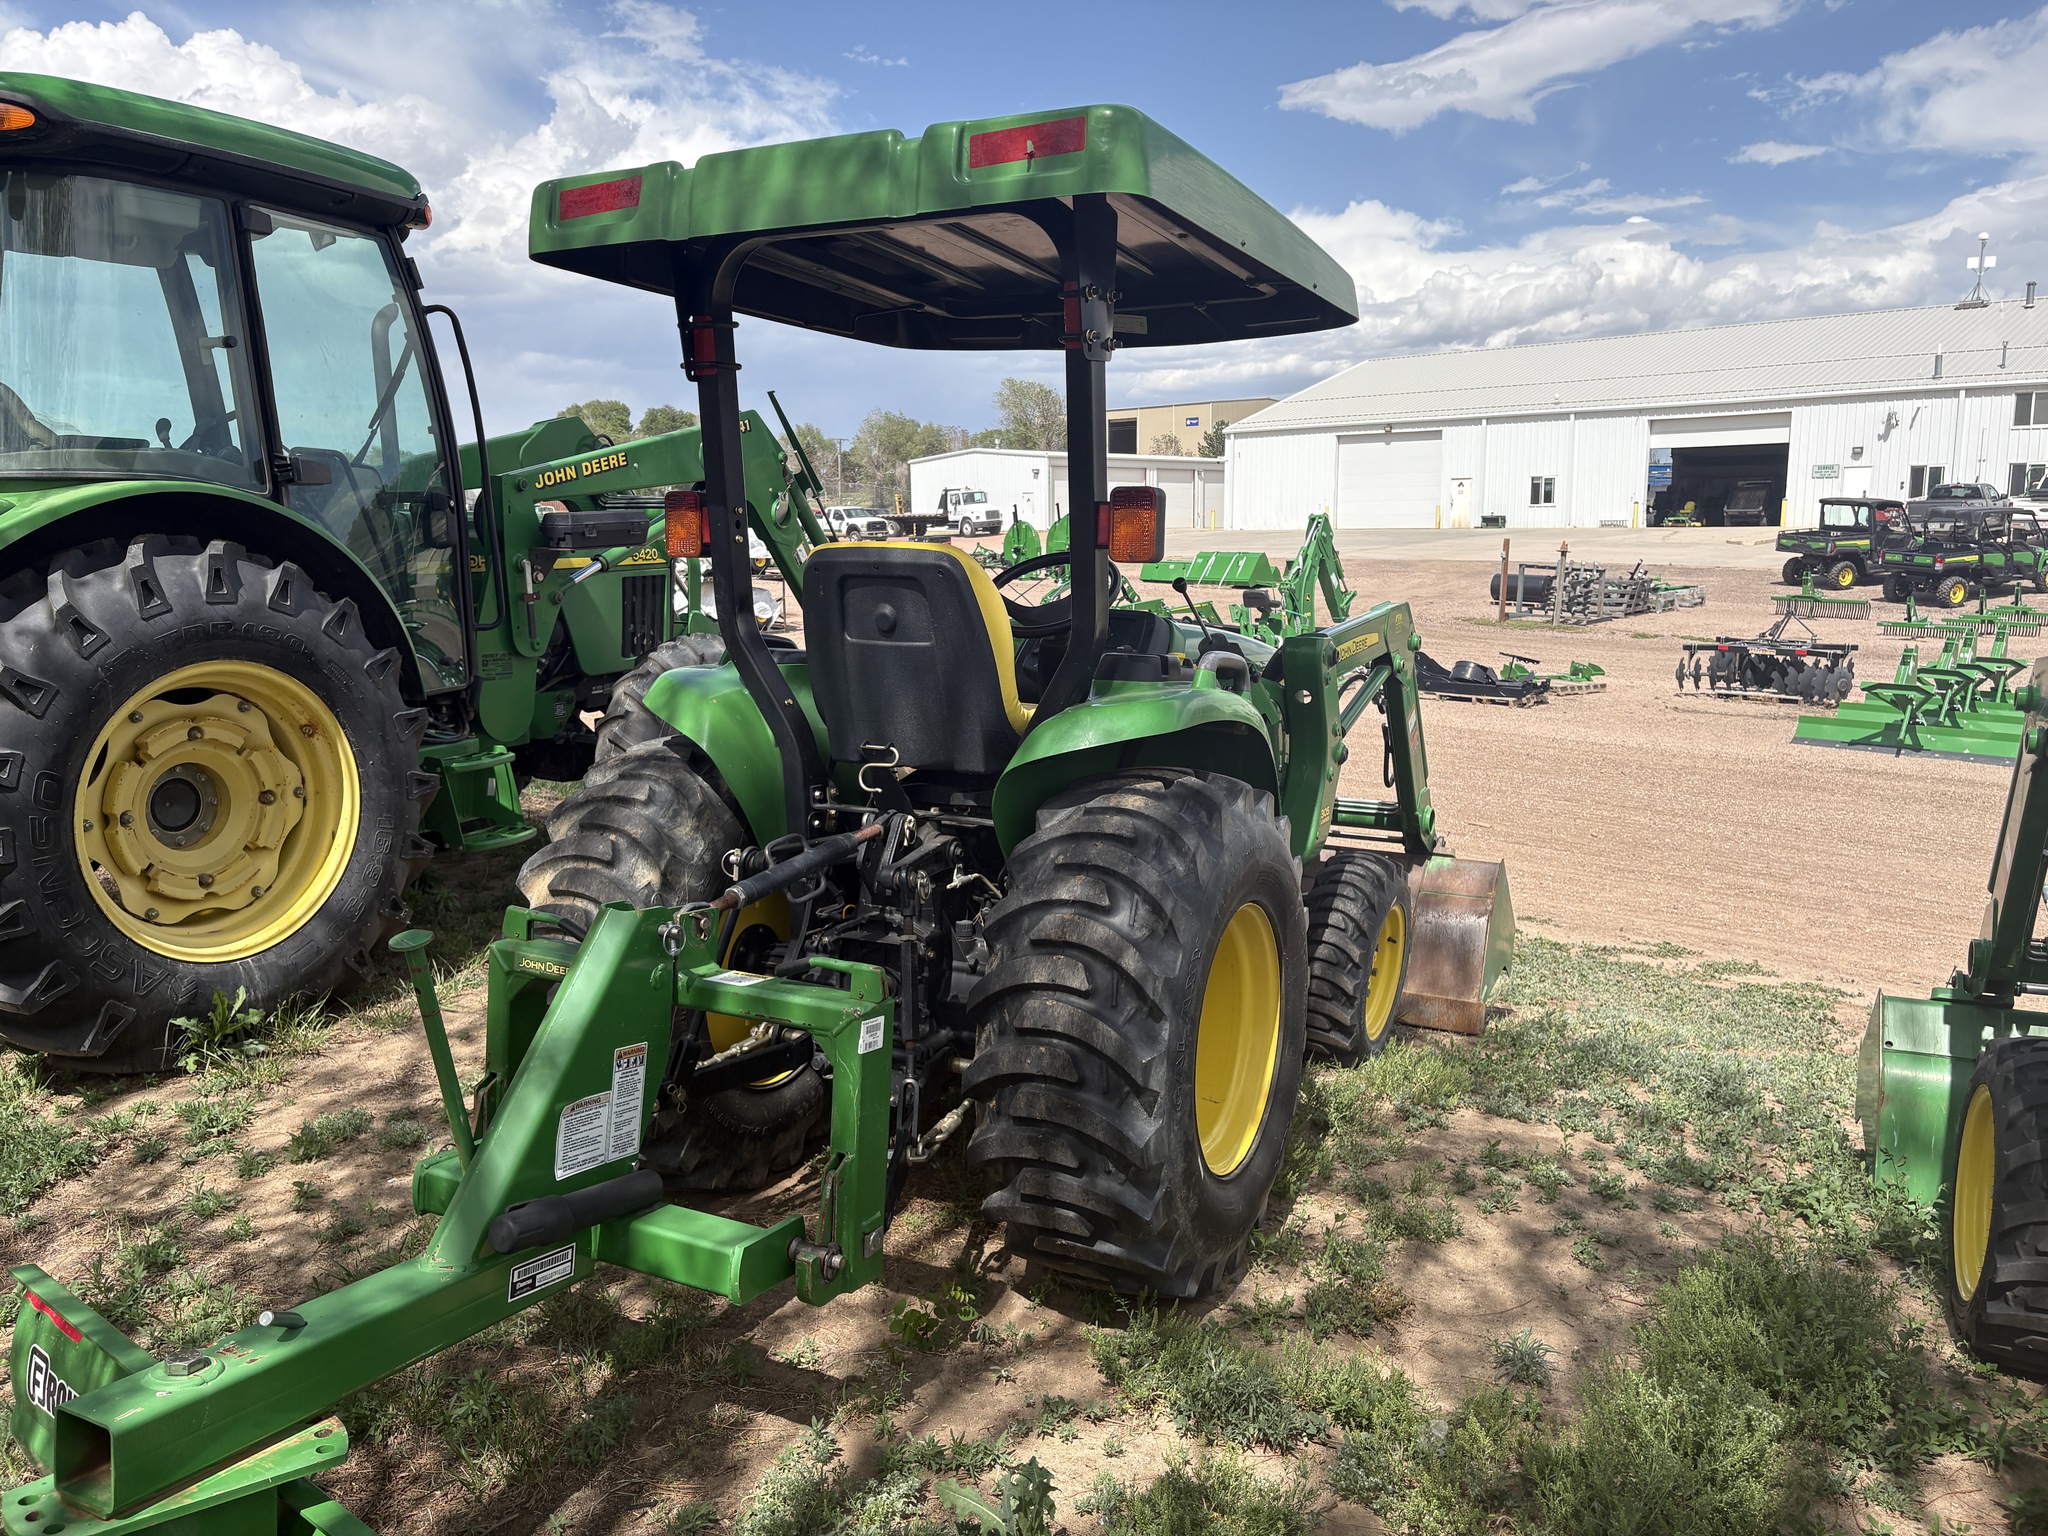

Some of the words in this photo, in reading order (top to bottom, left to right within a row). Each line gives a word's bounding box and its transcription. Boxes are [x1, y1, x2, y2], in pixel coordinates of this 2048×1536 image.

[535, 465, 577, 489] JOHN
[581, 452, 628, 476] DEERE
[632, 548, 658, 561] 5420
[1352, 637, 1368, 654] DEERE
[519, 957, 545, 971] JOHN
[622, 1047, 645, 1056] WARNING
[575, 1097, 601, 1110] WARNING
